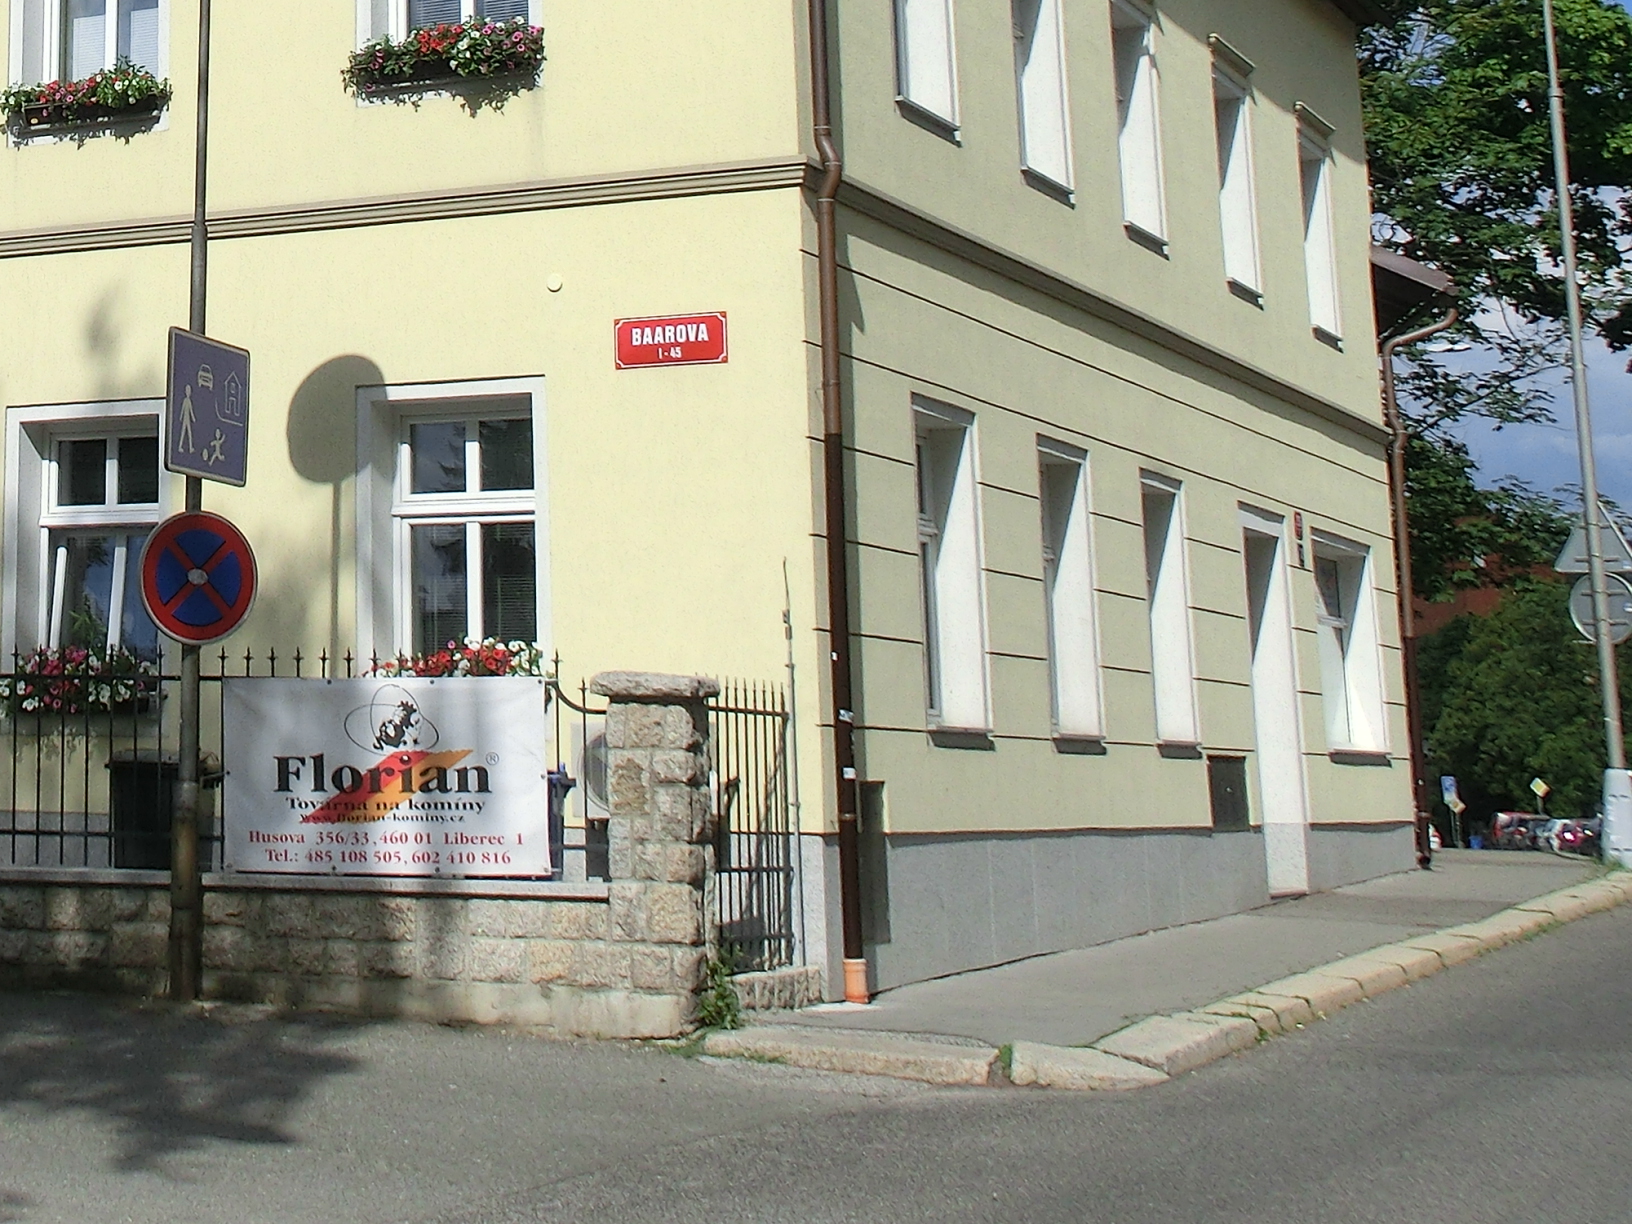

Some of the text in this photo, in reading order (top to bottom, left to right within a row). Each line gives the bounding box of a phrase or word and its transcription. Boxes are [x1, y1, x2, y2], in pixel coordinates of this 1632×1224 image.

[631, 323, 709, 345] BAAROVA
[273, 752, 493, 795] Florian
[375, 800, 401, 811] na
[407, 797, 486, 815] komíny
[248, 830, 306, 844] Husova
[379, 830, 409, 845] 460
[414, 832, 433, 845] 01
[443, 831, 506, 846] Liberec
[516, 832, 524, 845] 1
[265, 848, 299, 862] Tel.:
[304, 848, 334, 863] 485
[339, 850, 368, 864] 108
[411, 850, 441, 865] 602
[446, 849, 477, 865] 410
[481, 849, 512, 865] 816
